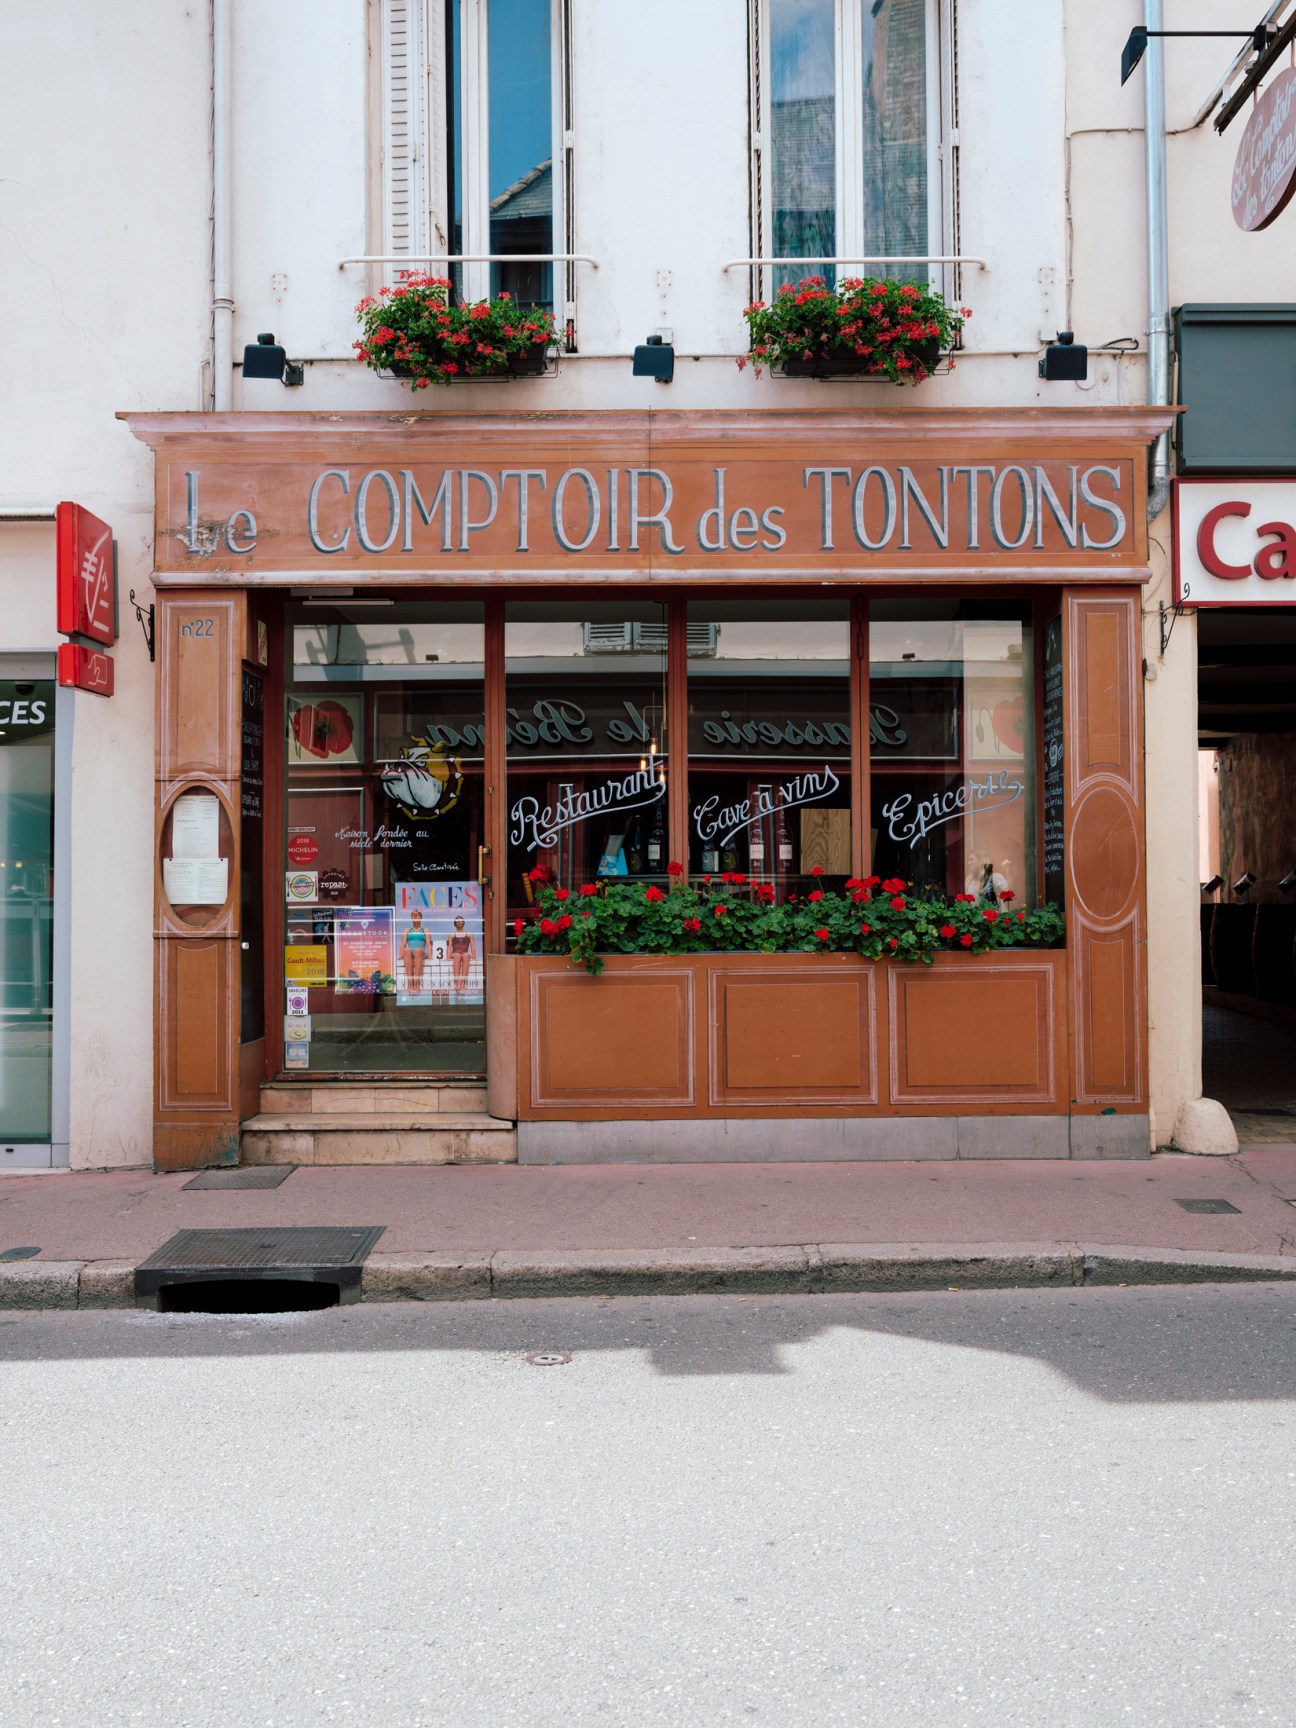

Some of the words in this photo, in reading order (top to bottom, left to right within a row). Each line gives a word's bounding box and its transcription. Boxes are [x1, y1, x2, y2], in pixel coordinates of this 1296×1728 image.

[183, 469, 258, 555] Le
[307, 468, 685, 555] COMPTOIR
[697, 467, 787, 551] des
[803, 465, 1127, 551] TONTONS
[510, 755, 666, 852] Restaurant
[693, 794, 751, 841] Cave
[778, 764, 840, 805] vins
[882, 768, 1022, 850] Epicerie
[373, 824, 409, 841] fondée
[416, 829, 430, 838] au
[380, 838, 413, 848] dernier
[401, 886, 478, 909] FACES
[436, 947, 444, 960] 3
